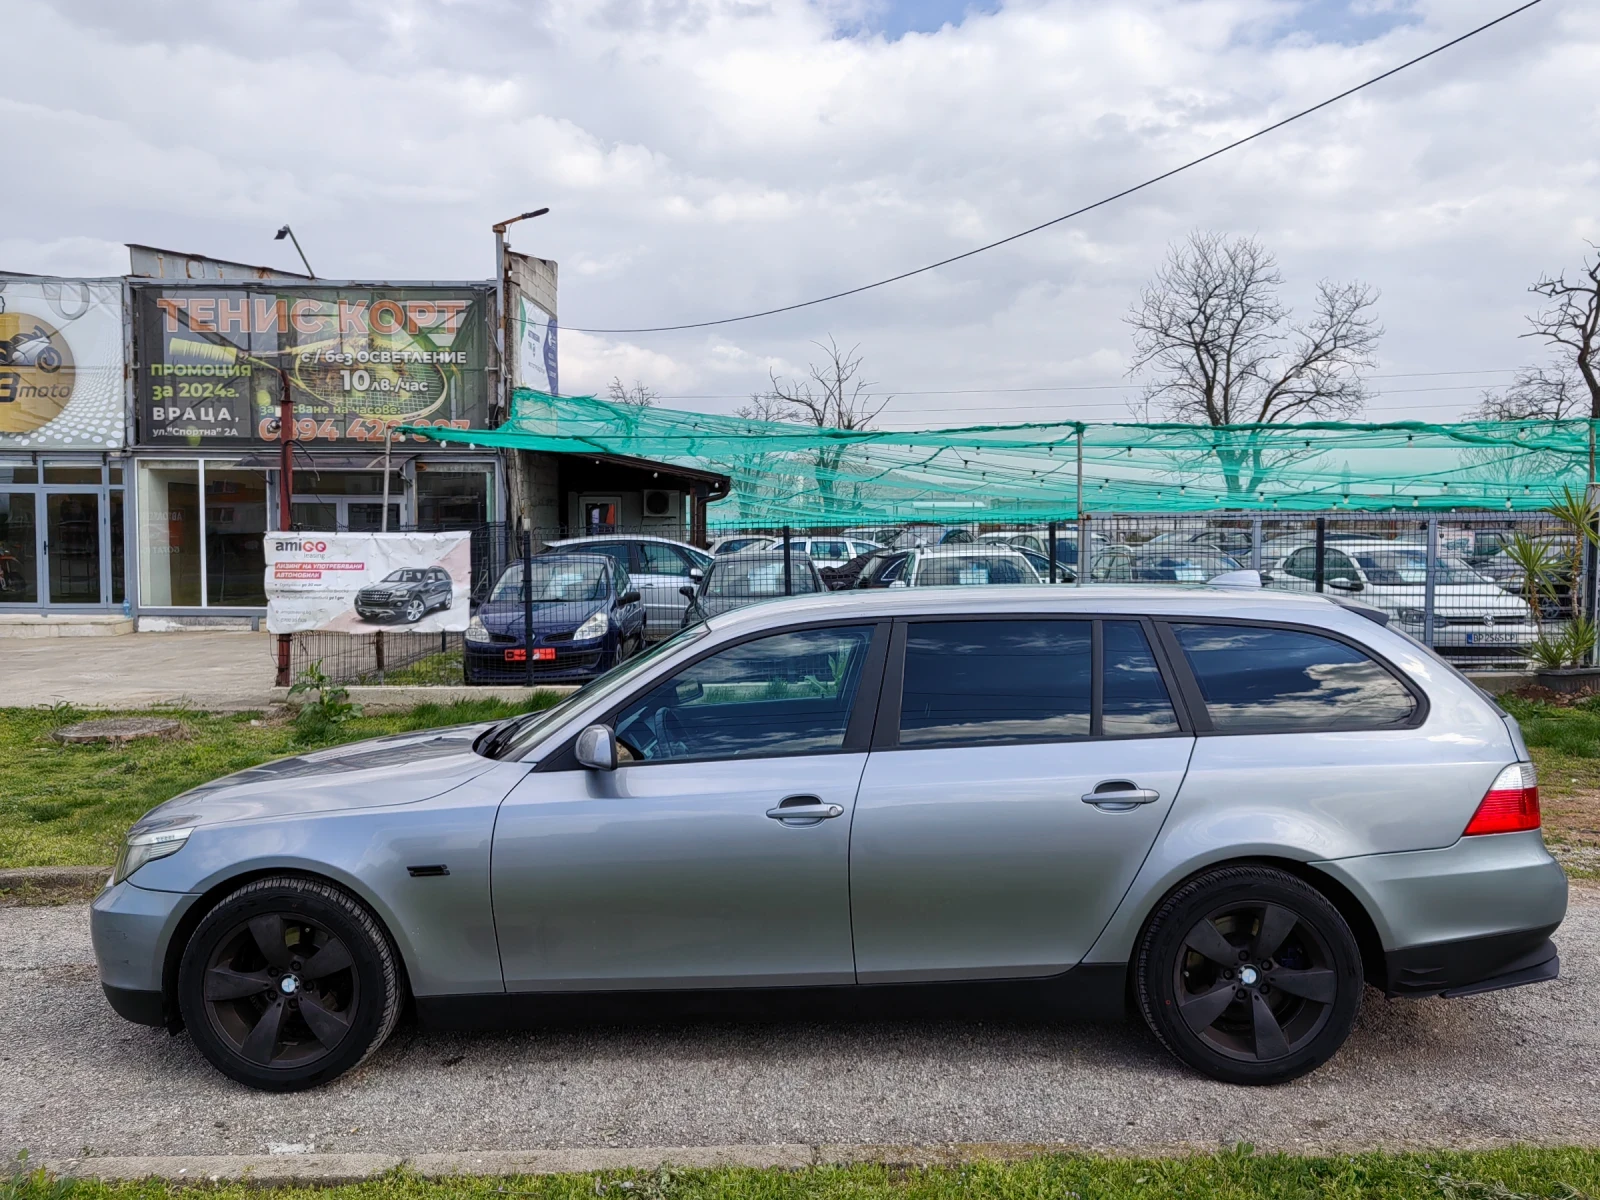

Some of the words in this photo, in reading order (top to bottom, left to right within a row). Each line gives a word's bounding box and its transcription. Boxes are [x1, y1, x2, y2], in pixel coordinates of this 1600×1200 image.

[156, 298, 324, 334] ТЕНИС
[337, 299, 466, 335] КОРТ
[325, 350, 353, 366] без
[357, 351, 467, 363] ОСВЕТЛЕНИЕ
[150, 364, 252, 378] ПРОМОЦИЯ
[152, 385, 173, 400] за
[152, 407, 240, 423] ВРАЦА,
[260, 404, 330, 416] засване
[333, 406, 349, 414] на
[352, 405, 401, 415] часове:
